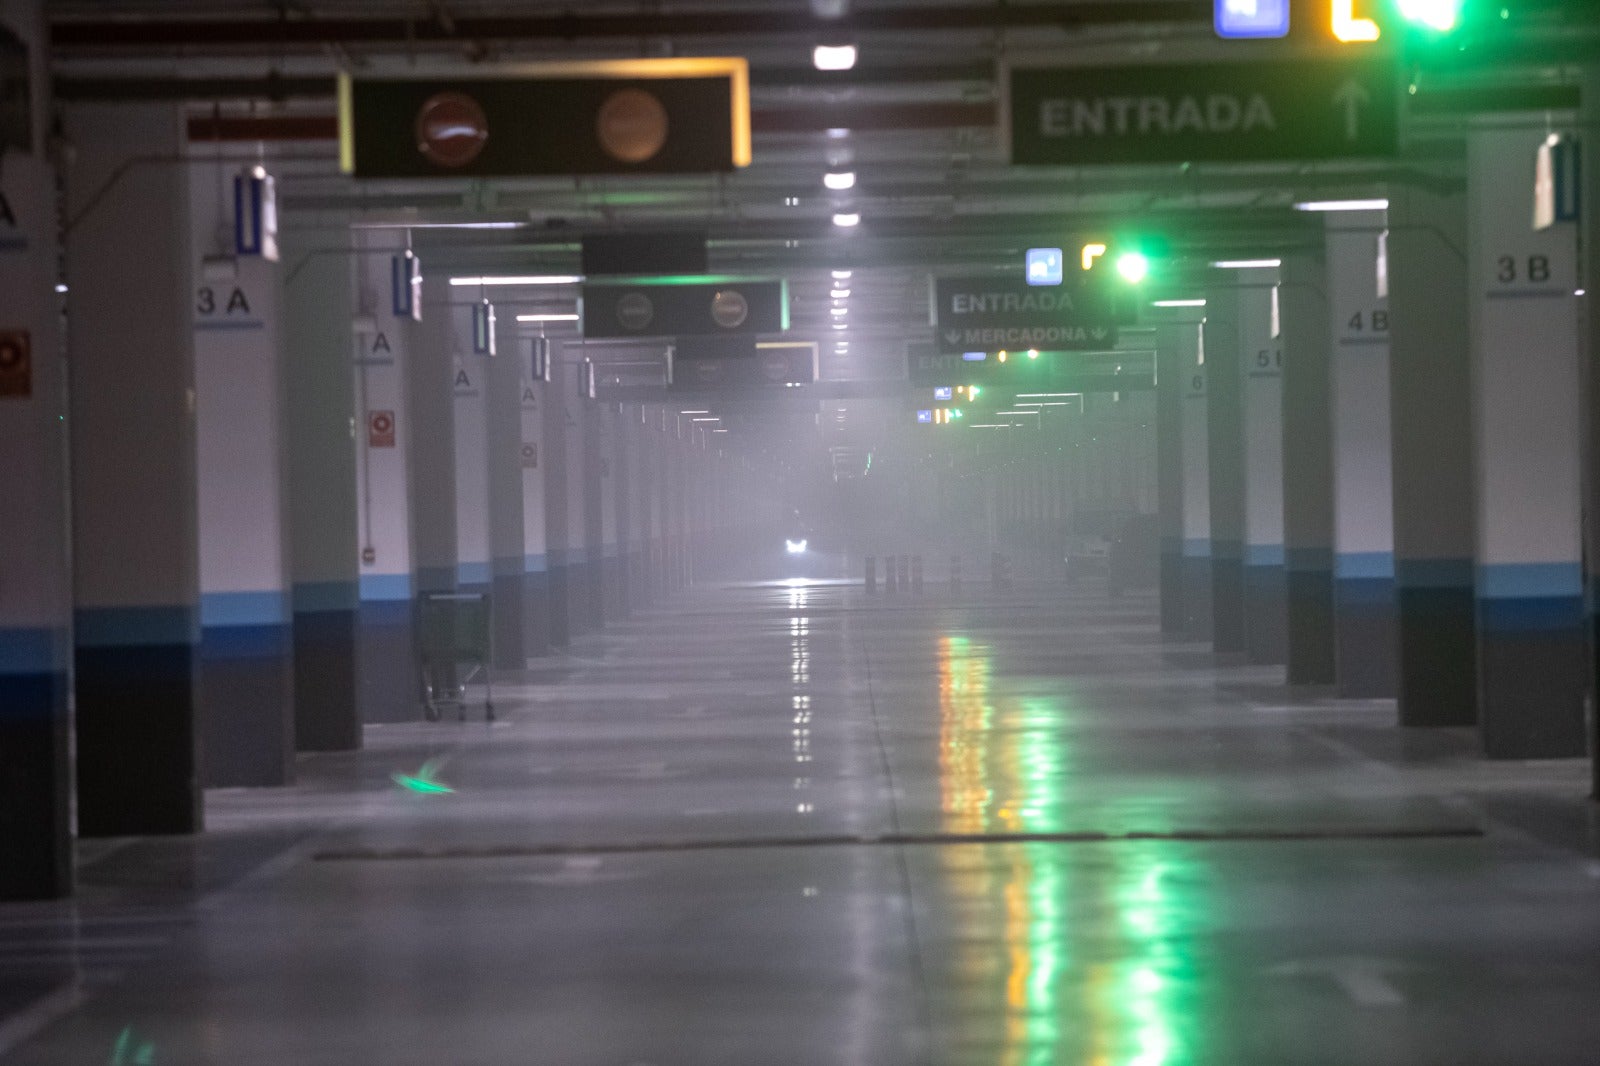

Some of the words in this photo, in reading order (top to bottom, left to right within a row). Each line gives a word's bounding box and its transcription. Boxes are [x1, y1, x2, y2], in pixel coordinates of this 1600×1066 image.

[1040, 94, 1276, 137] ENTRADA
[1498, 255, 1516, 283] 3
[1528, 254, 1551, 282] B
[197, 287, 215, 314] 3
[226, 286, 250, 313] A
[952, 293, 1074, 314] ENTRADA
[1347, 311, 1363, 331] 4
[1372, 310, 1389, 331] B
[372, 332, 391, 353] A
[965, 327, 1087, 345] MERCADONA
[1257, 350, 1270, 367] 5
[454, 368, 471, 387] A
